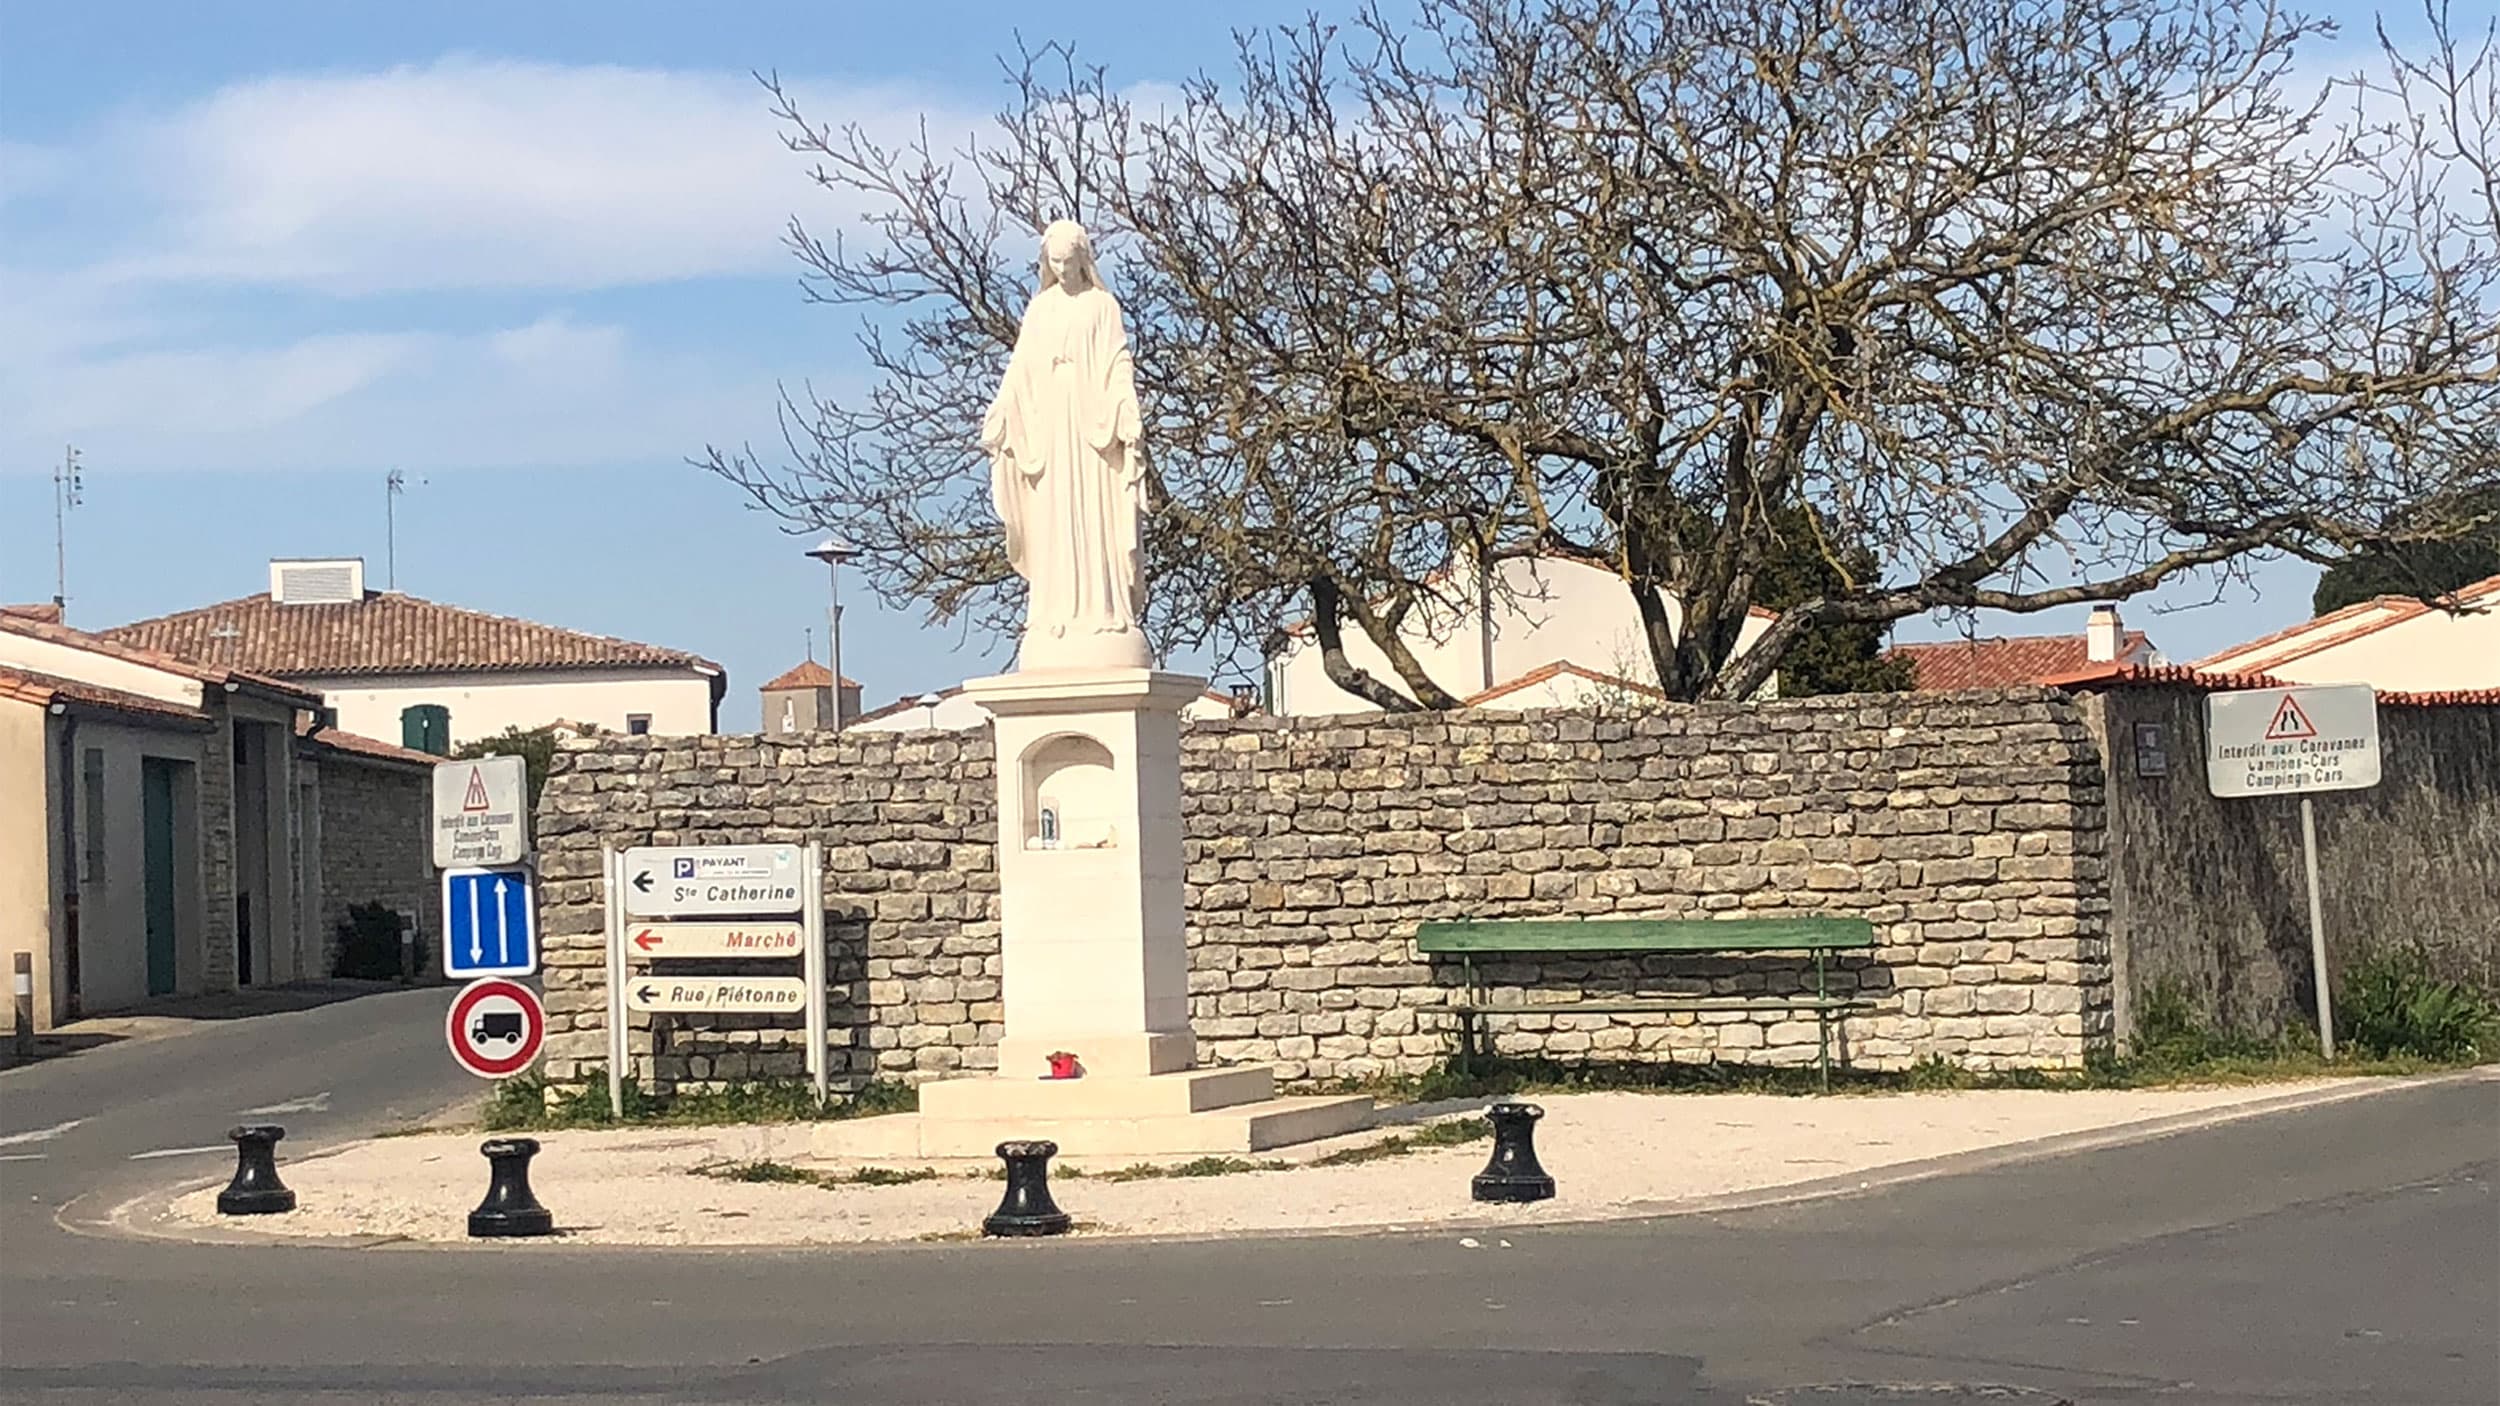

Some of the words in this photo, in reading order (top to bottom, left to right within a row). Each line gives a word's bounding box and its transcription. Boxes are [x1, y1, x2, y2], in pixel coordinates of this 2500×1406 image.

[2219, 744, 2266, 759] Interdit
[2271, 743, 2293, 755] aux
[2300, 739, 2365, 754] Caravanes
[2314, 769, 2343, 783] Cars
[702, 857, 745, 866] PAYANT
[707, 884, 796, 901] Catherine
[726, 931, 796, 948] Marché
[671, 986, 704, 1002] Rue
[715, 984, 797, 1002] Piétonne
